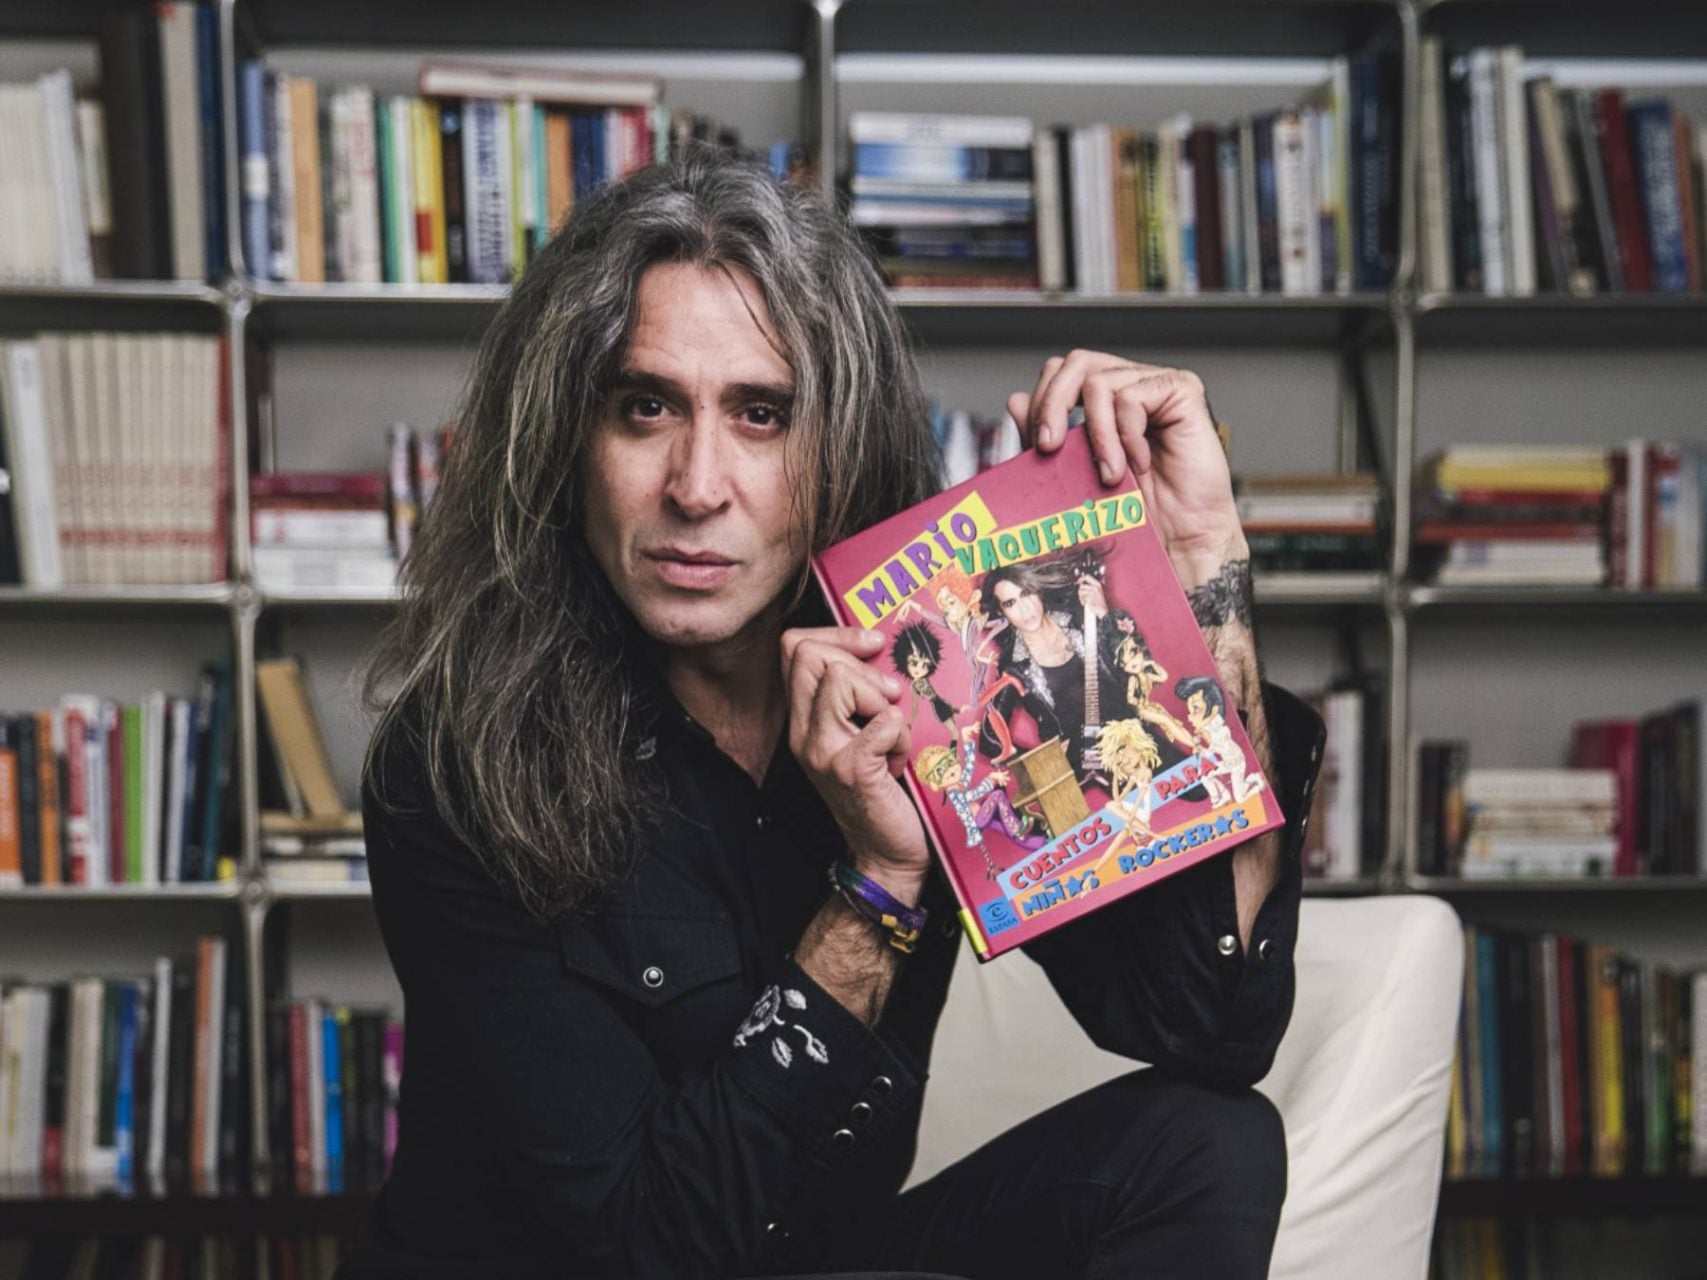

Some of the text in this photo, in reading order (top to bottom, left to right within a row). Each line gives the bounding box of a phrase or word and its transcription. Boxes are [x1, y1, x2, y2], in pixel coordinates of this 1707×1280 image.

[855, 513, 977, 618] MARIO
[955, 496, 1143, 574] VAQUERIZO
[1009, 757, 1218, 890] CUENTOS PARA
